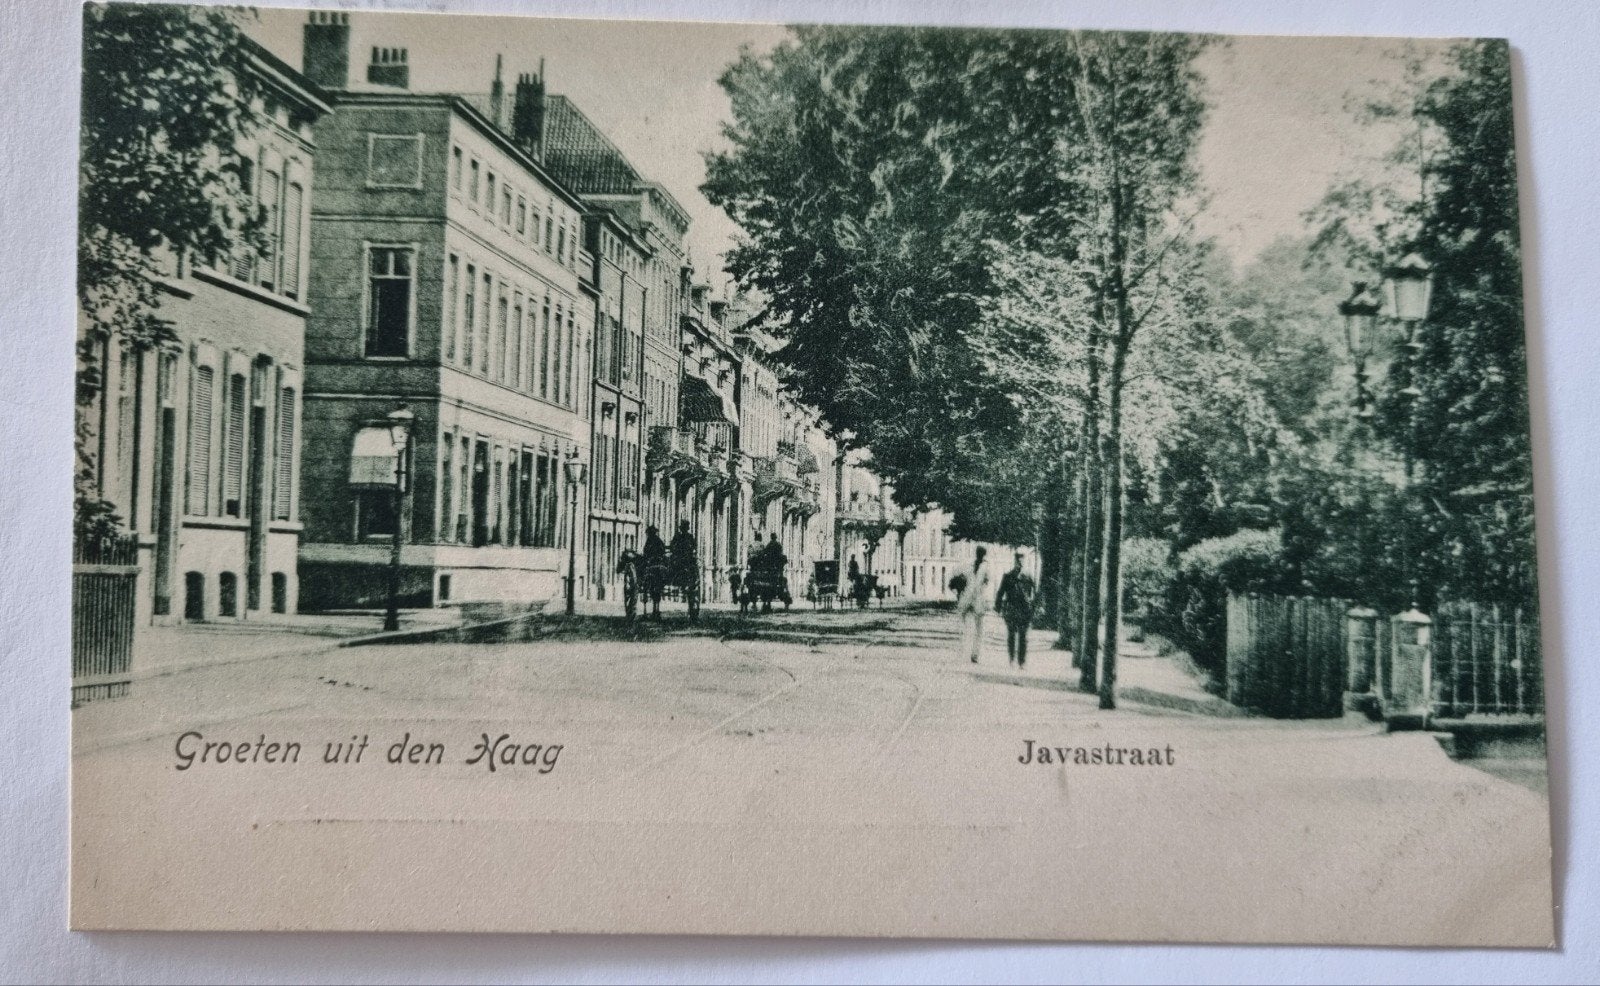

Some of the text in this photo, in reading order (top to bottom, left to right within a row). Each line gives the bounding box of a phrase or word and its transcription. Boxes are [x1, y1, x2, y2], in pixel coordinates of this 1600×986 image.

[175, 731, 564, 774] Groeten uit den Haag
[1018, 739, 1175, 766] Javastraat
